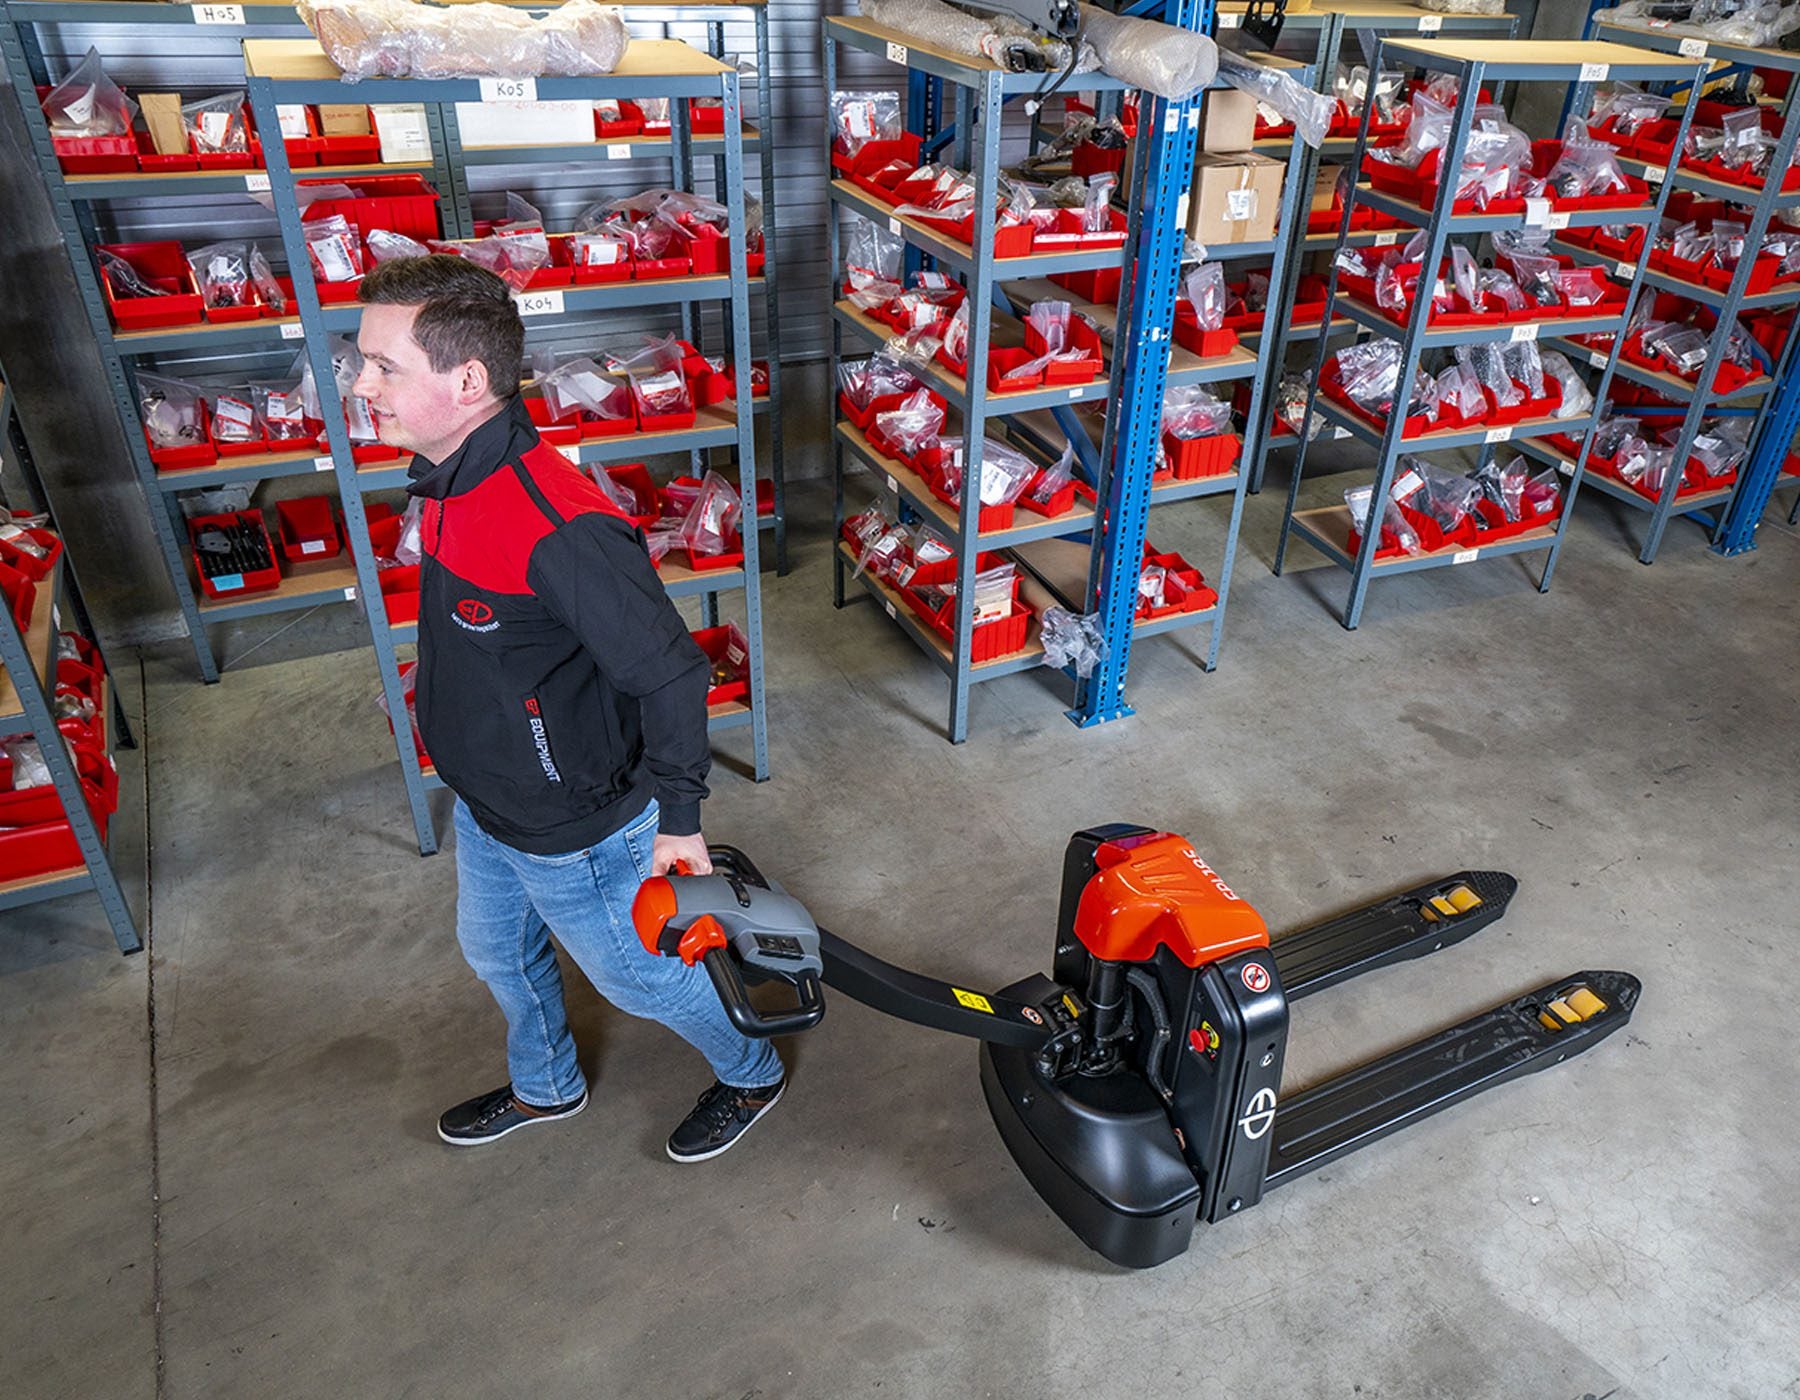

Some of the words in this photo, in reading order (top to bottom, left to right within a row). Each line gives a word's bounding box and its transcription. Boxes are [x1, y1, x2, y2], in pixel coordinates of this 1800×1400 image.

[203, 7, 236, 22] H05
[496, 82, 525, 97] K05
[523, 297, 553, 312] K04
[525, 697, 540, 716] EP
[529, 717, 561, 783] EQUIPMENT
